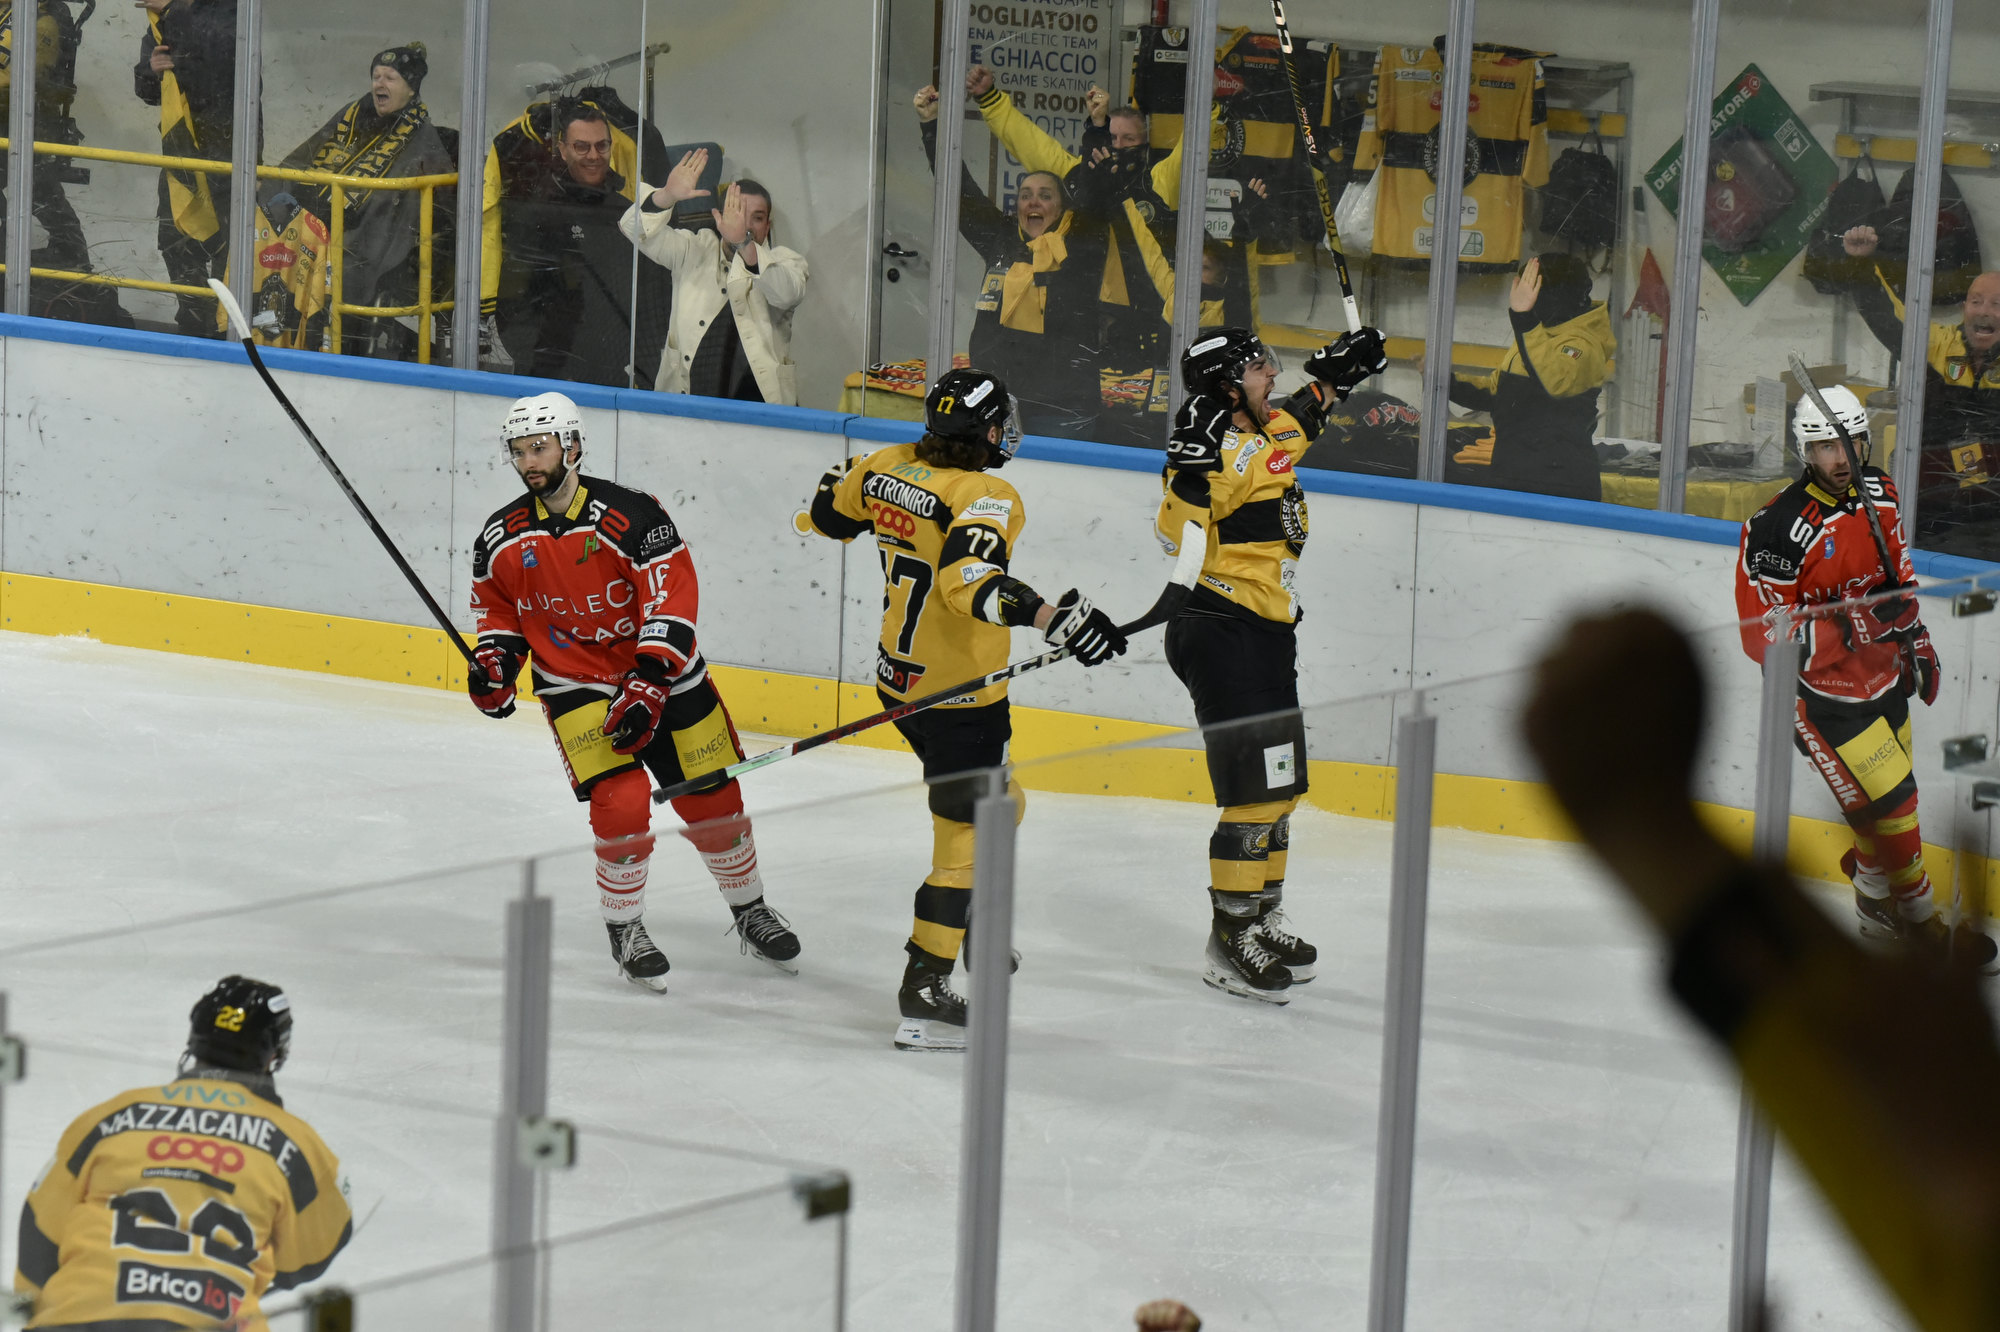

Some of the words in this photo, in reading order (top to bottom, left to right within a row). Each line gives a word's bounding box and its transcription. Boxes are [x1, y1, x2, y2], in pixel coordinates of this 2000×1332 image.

[968, 27, 994, 40] ENA
[1000, 30, 1058, 47] ATHLETIC
[1063, 35, 1098, 49] TEAM
[991, 47, 1097, 75] GHIACCIO
[1001, 72, 1038, 87] GAME
[1203, 363, 1223, 374] CCM
[508, 416, 529, 425] CCM
[966, 527, 999, 560] 77
[985, 647, 1071, 687] CCM
[696, 727, 728, 760] IMECO
[1865, 737, 1896, 769] IMECO
[214, 1004, 246, 1032] 22
[160, 1085, 247, 1107] VIVO
[147, 1135, 246, 1176] coop
